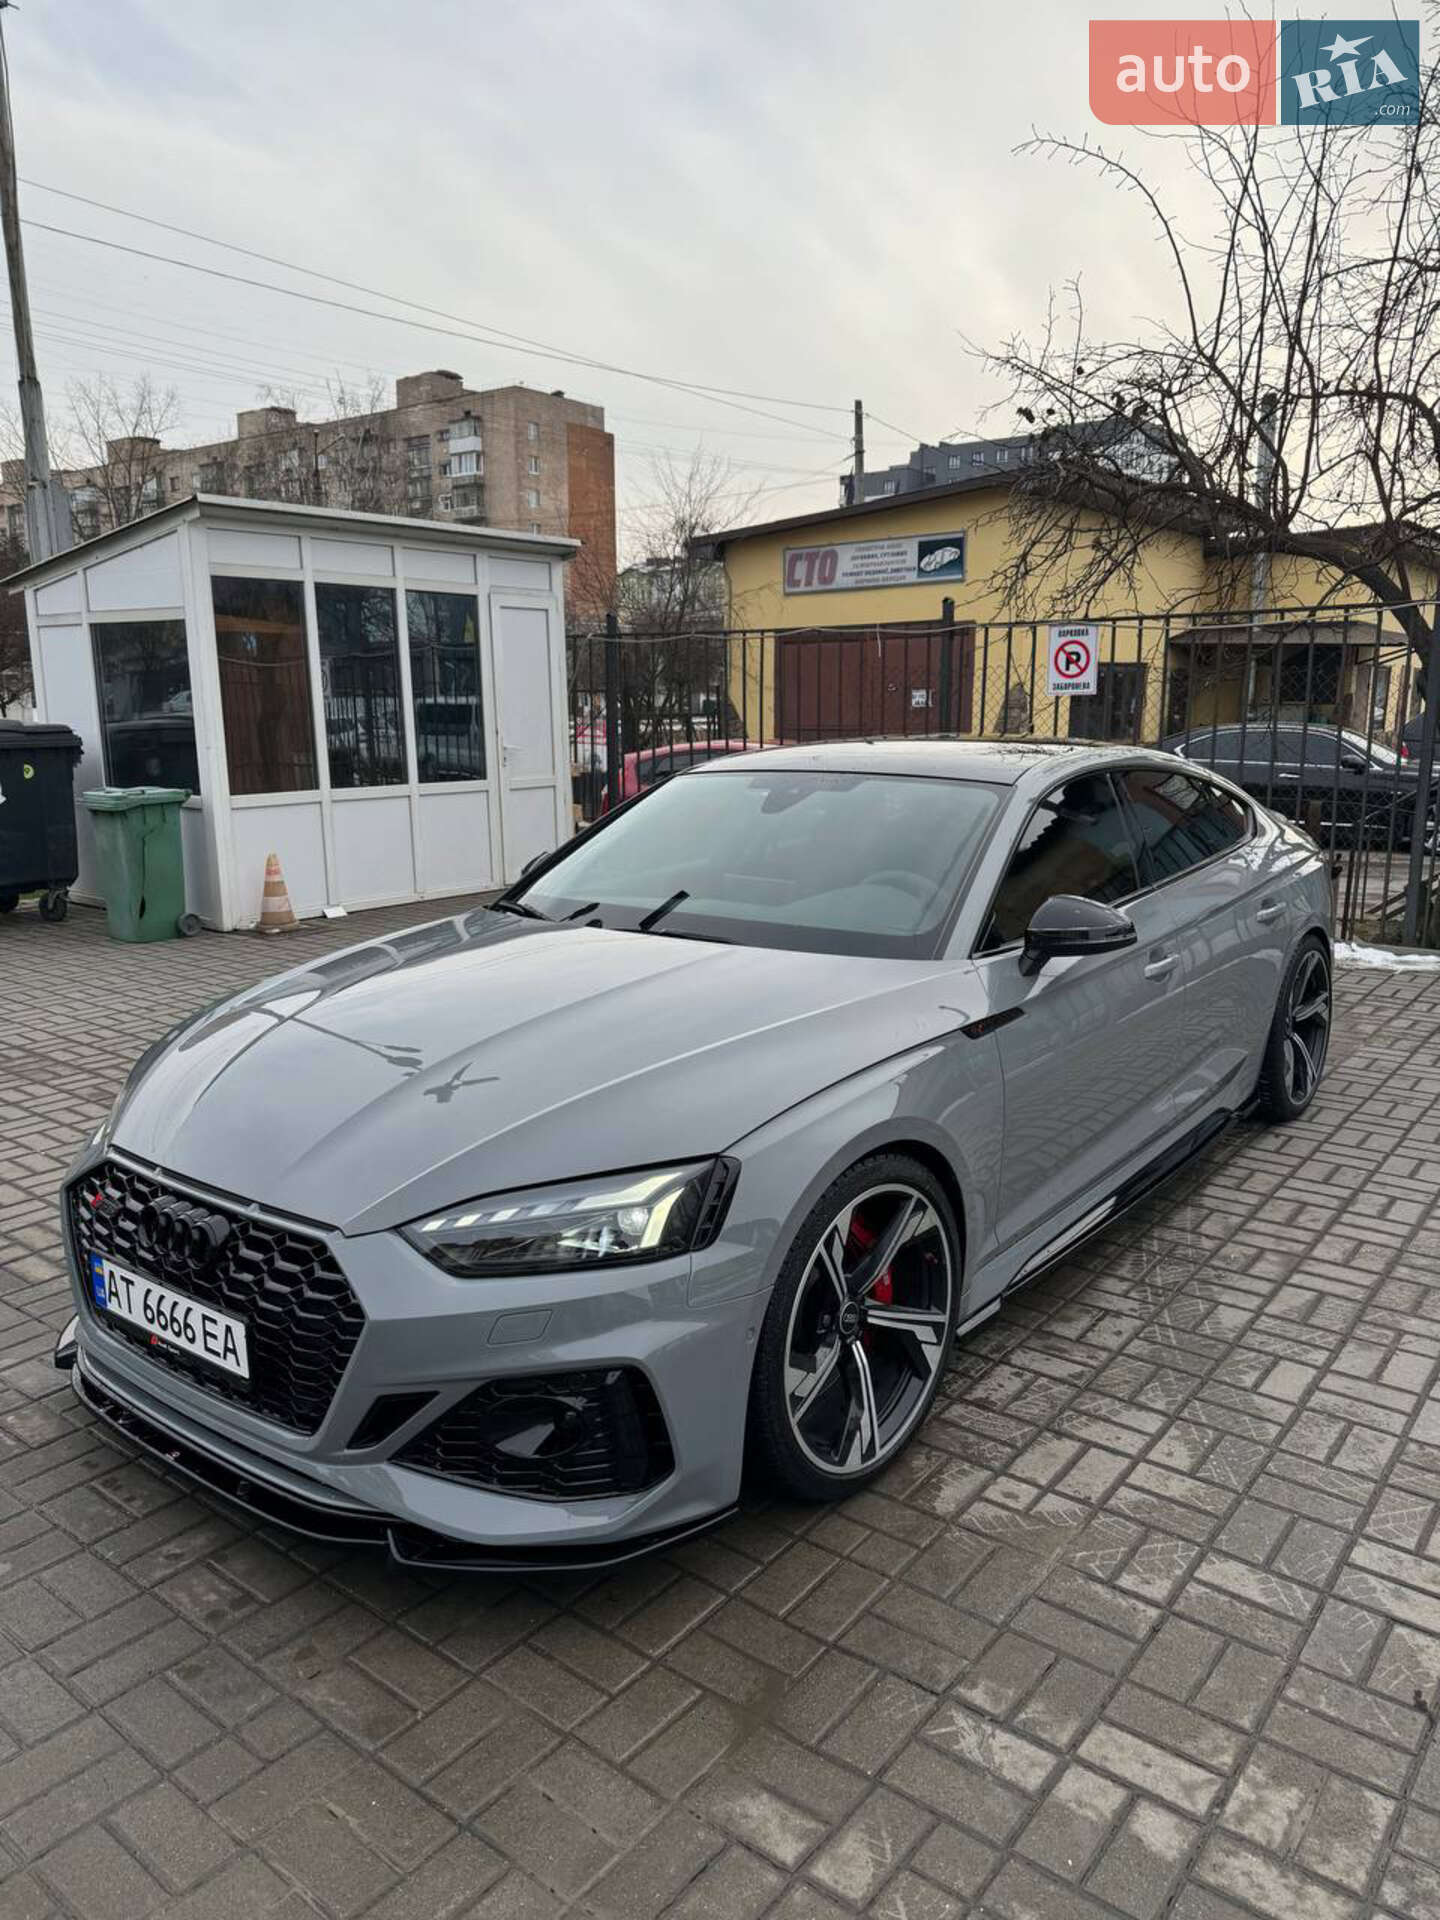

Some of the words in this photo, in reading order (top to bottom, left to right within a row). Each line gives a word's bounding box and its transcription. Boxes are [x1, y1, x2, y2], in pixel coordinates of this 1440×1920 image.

[786, 549, 839, 588] СТО
[107, 1270, 135, 1315] AT
[143, 1288, 196, 1344] 6666
[201, 1313, 241, 1368] EA
